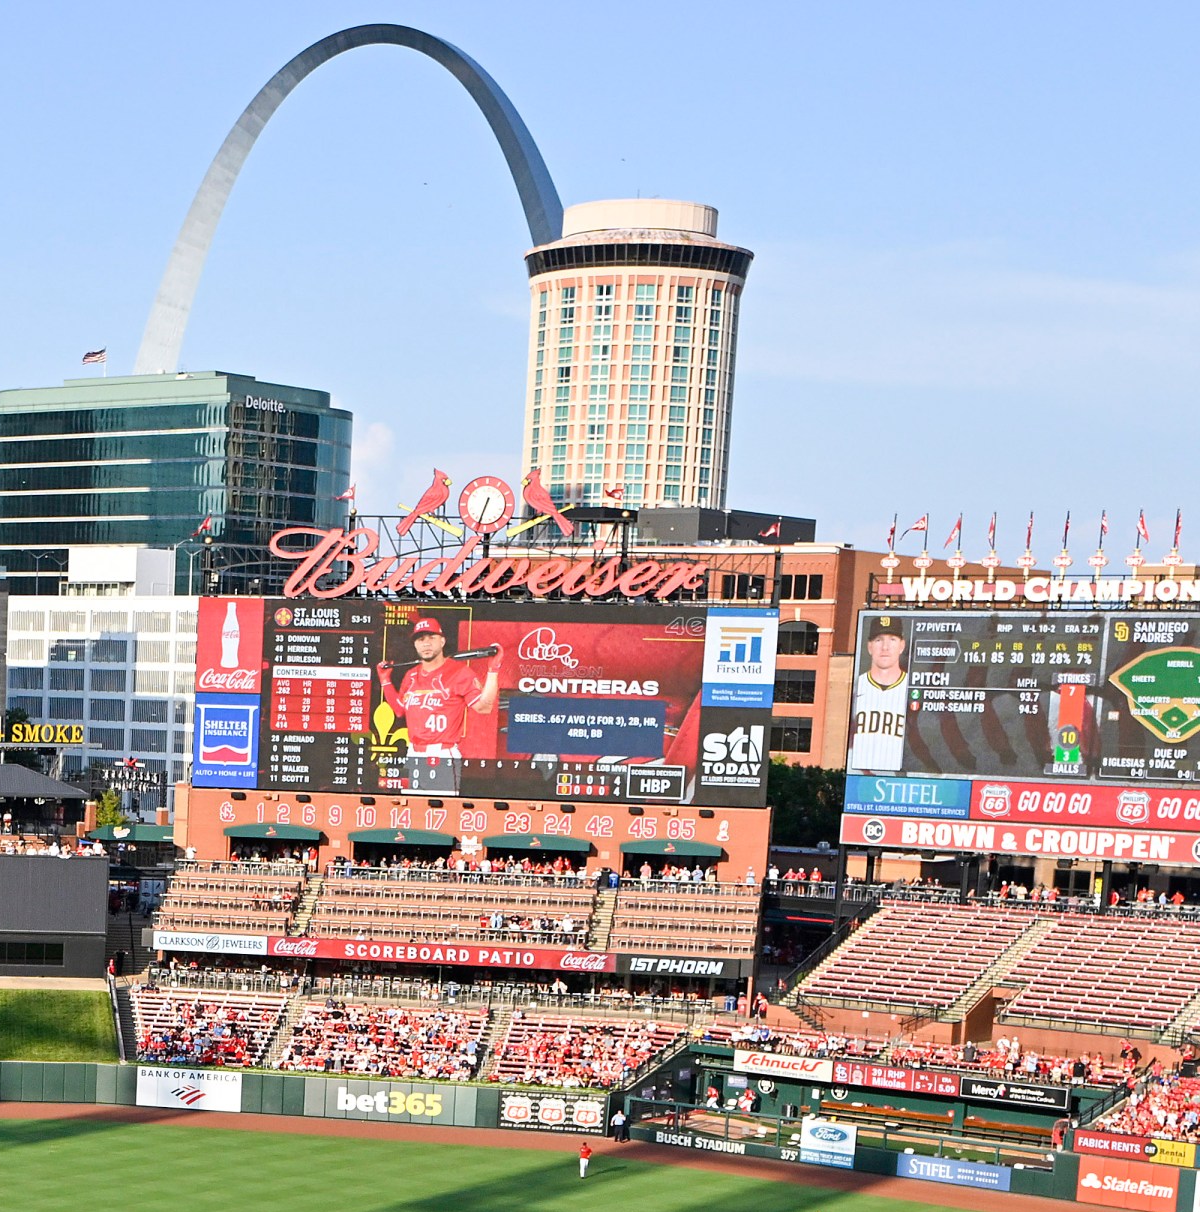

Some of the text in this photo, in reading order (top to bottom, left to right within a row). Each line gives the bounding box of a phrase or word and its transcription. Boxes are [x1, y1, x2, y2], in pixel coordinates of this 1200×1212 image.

[246, 394, 286, 413] Deloitte.
[269, 527, 708, 599] Budweiser
[902, 577, 1016, 601] WORLD
[294, 608, 339, 618] ST. LOUIS
[294, 618, 340, 627] CARDINALS
[916, 622, 962, 632] 27 PIVETTA
[997, 624, 1012, 632] RHP
[1039, 625, 1056, 633] 10-2
[1134, 622, 1188, 632] SAN DIEGO
[1082, 626, 1098, 634] 2.79
[1134, 632, 1174, 642] PADRES
[917, 646, 956, 656] THIS SEASON
[964, 652, 1092, 664] 116.1 85 30 128 28% 7%
[716, 665, 762, 674] First Mid
[1167, 660, 1194, 668] MERRILL
[200, 668, 259, 690] Coca-Cola
[912, 673, 1037, 688] PITCH MPH
[1058, 674, 1090, 683] STRIKES
[518, 678, 659, 696] CONTRERAS
[924, 690, 1038, 702] FOUR-SEAM FB 93.7
[922, 702, 1038, 714] FOUR-SEAM FB 94.5
[205, 720, 248, 730] SHELTER
[425, 714, 447, 732] 40
[514, 714, 614, 725] SERIES: .667 AVG FOR
[12, 723, 84, 744] SMOKE
[590, 730, 602, 738] BB
[1062, 732, 1076, 744] 10
[1154, 748, 1187, 759] DUE UP
[703, 762, 761, 776] TODAY
[1052, 764, 1079, 774] BALLS
[1108, 758, 1145, 768] IGLESIAS
[640, 779, 671, 794] HBP
[874, 779, 942, 805] STIFEL
[984, 799, 1006, 810] 66
[1018, 791, 1090, 814] GO GO GO
[356, 806, 376, 827] 10
[390, 808, 410, 829] 14
[1122, 806, 1144, 818] 66
[426, 809, 446, 830] 17
[460, 811, 488, 832] 20
[504, 812, 531, 834] 23
[544, 814, 572, 835] 24
[585, 814, 613, 837] 42
[628, 816, 657, 838] 45
[668, 817, 695, 840] 85
[901, 822, 1170, 859] BROWN & CROUPPEN
[158, 936, 263, 950] CLARKSON JEWELERS
[274, 938, 318, 956] Coca-Cola
[345, 942, 536, 965] SCOREBOARD PATIO
[560, 952, 606, 970] Coca-Cola
[742, 1054, 824, 1072] Schnucks
[141, 1070, 238, 1082] BANK OF AMERICA
[890, 1070, 906, 1079] RHP
[872, 1076, 906, 1090] Mikolas
[972, 1084, 998, 1096] Mercy
[336, 1087, 442, 1116] bet365
[816, 1128, 842, 1142] Ford
[656, 1132, 746, 1154] BUSCH STADIUM
[1078, 1136, 1186, 1158] FABICK RENTS Rental
[780, 1150, 798, 1160] 375'
[908, 1158, 954, 1180] STIFEL
